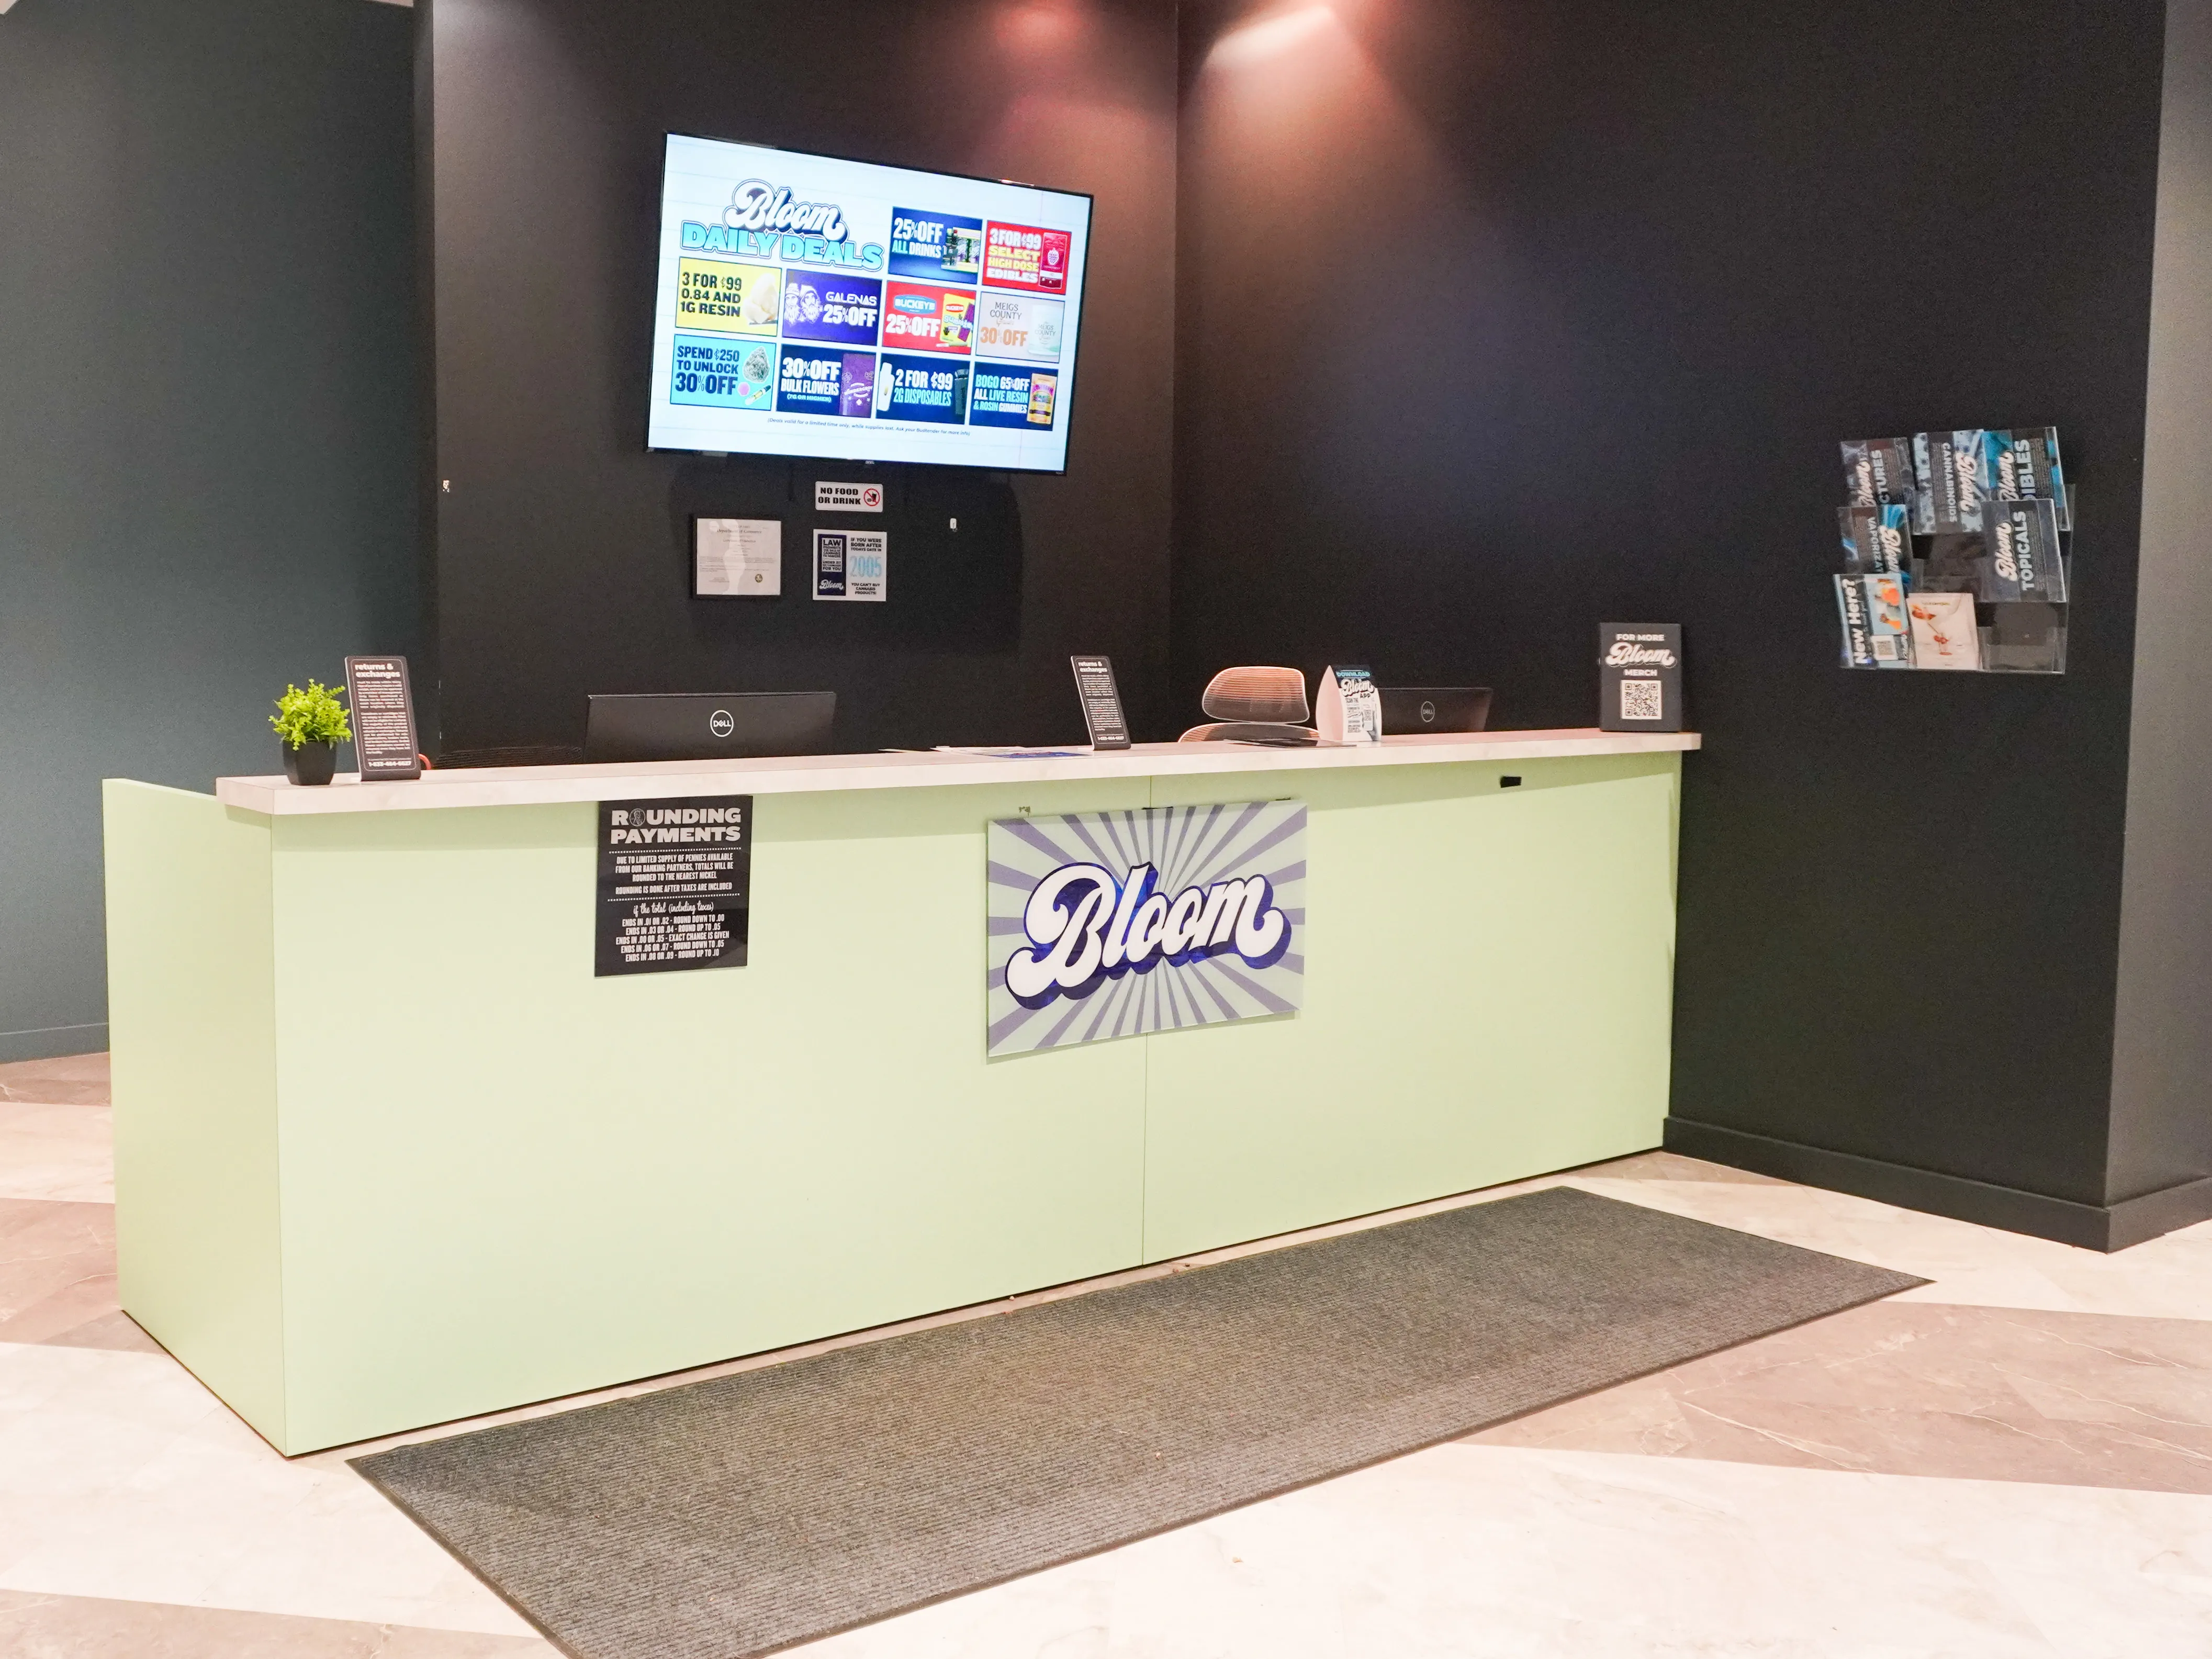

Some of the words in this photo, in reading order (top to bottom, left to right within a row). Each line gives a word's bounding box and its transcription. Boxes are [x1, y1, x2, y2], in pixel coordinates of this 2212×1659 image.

[724, 179, 848, 243] Bloom
[682, 222, 779, 257] DAILY
[782, 234, 883, 271] DEALS
[1000, 230, 1022, 247] FOR
[892, 240, 908, 254] ALL
[909, 243, 942, 259] DRINKS
[989, 245, 1041, 262] SELECT
[987, 256, 1012, 269] HIGH
[1013, 259, 1039, 272] DOSE
[682, 272, 690, 286] 3
[693, 275, 717, 288] FOR
[720, 276, 742, 290] $99
[986, 268, 1038, 284] EDIBLES
[682, 289, 709, 301] 0.84
[713, 292, 740, 304] AND
[825, 292, 877, 306] GALENAS
[894, 296, 935, 311] BUCKEYE
[681, 301, 695, 313] 1G
[699, 304, 740, 317] RESIN
[990, 309, 1022, 320] COUNTY
[995, 301, 1019, 311] MEIGS
[677, 346, 713, 360] SPEND
[714, 348, 739, 363] $250
[677, 360, 691, 371] TO
[693, 361, 738, 374] UNLOCK
[781, 378, 803, 394] BULK
[804, 379, 839, 396] FLOWERS
[895, 368, 903, 386] 2
[905, 370, 928, 388] FOR
[930, 372, 953, 390] $99
[975, 374, 1000, 388] BOGO
[806, 395, 832, 403] HIGHER)
[893, 388, 904, 402] 2G
[905, 388, 952, 406] DISPOSABLES
[974, 388, 988, 400] ALL
[989, 389, 1006, 401] LIVE
[1006, 391, 1028, 403] RESIN
[973, 401, 979, 410] &
[980, 401, 998, 411] ROSIN
[998, 402, 1027, 414] GUMMIES
[1942, 443, 1957, 522] CANNABINOIDS
[1955, 452, 1977, 511] Bloom
[1994, 521, 2020, 581] Bloom
[2013, 510, 2035, 591] TOPICALS
[850, 555, 882, 578] 2005
[1842, 578, 1862, 625] Here?
[1851, 628, 1867, 664] New
[1605, 642, 1677, 668] Bloom
[356, 670, 400, 679] exchanges
[1341, 679, 1375, 697] Bloom
[611, 826, 741, 844] PAYMENTS
[657, 855, 677, 863] SUPPLY
[707, 853, 733, 861] AVAILABLE
[615, 865, 630, 873] FROM
[631, 865, 642, 873] OUR
[643, 864, 666, 872] BANKING
[666, 863, 693, 871] PARTNERS,
[632, 873, 656, 882] ROUNDED
[676, 872, 698, 880] NEAREST
[615, 886, 642, 895] ROUNDING
[649, 885, 663, 893] DONE
[664, 884, 680, 893] AFTER
[681, 884, 697, 892] TAXES
[708, 882, 732, 891] INCLUDED
[633, 905, 638, 917] if
[640, 902, 650, 914] the
[652, 902, 666, 914] total
[669, 901, 695, 915] (including
[697, 900, 714, 912] taxes)
[622, 918, 636, 927] ENDS
[637, 918, 643, 926] IN
[652, 917, 660, 926] OR
[661, 917, 669, 925] .02
[673, 916, 691, 925] ROUND
[692, 915, 708, 924] DOWN
[709, 914, 715, 923] TO
[1005, 861, 1292, 1010] Bloom
